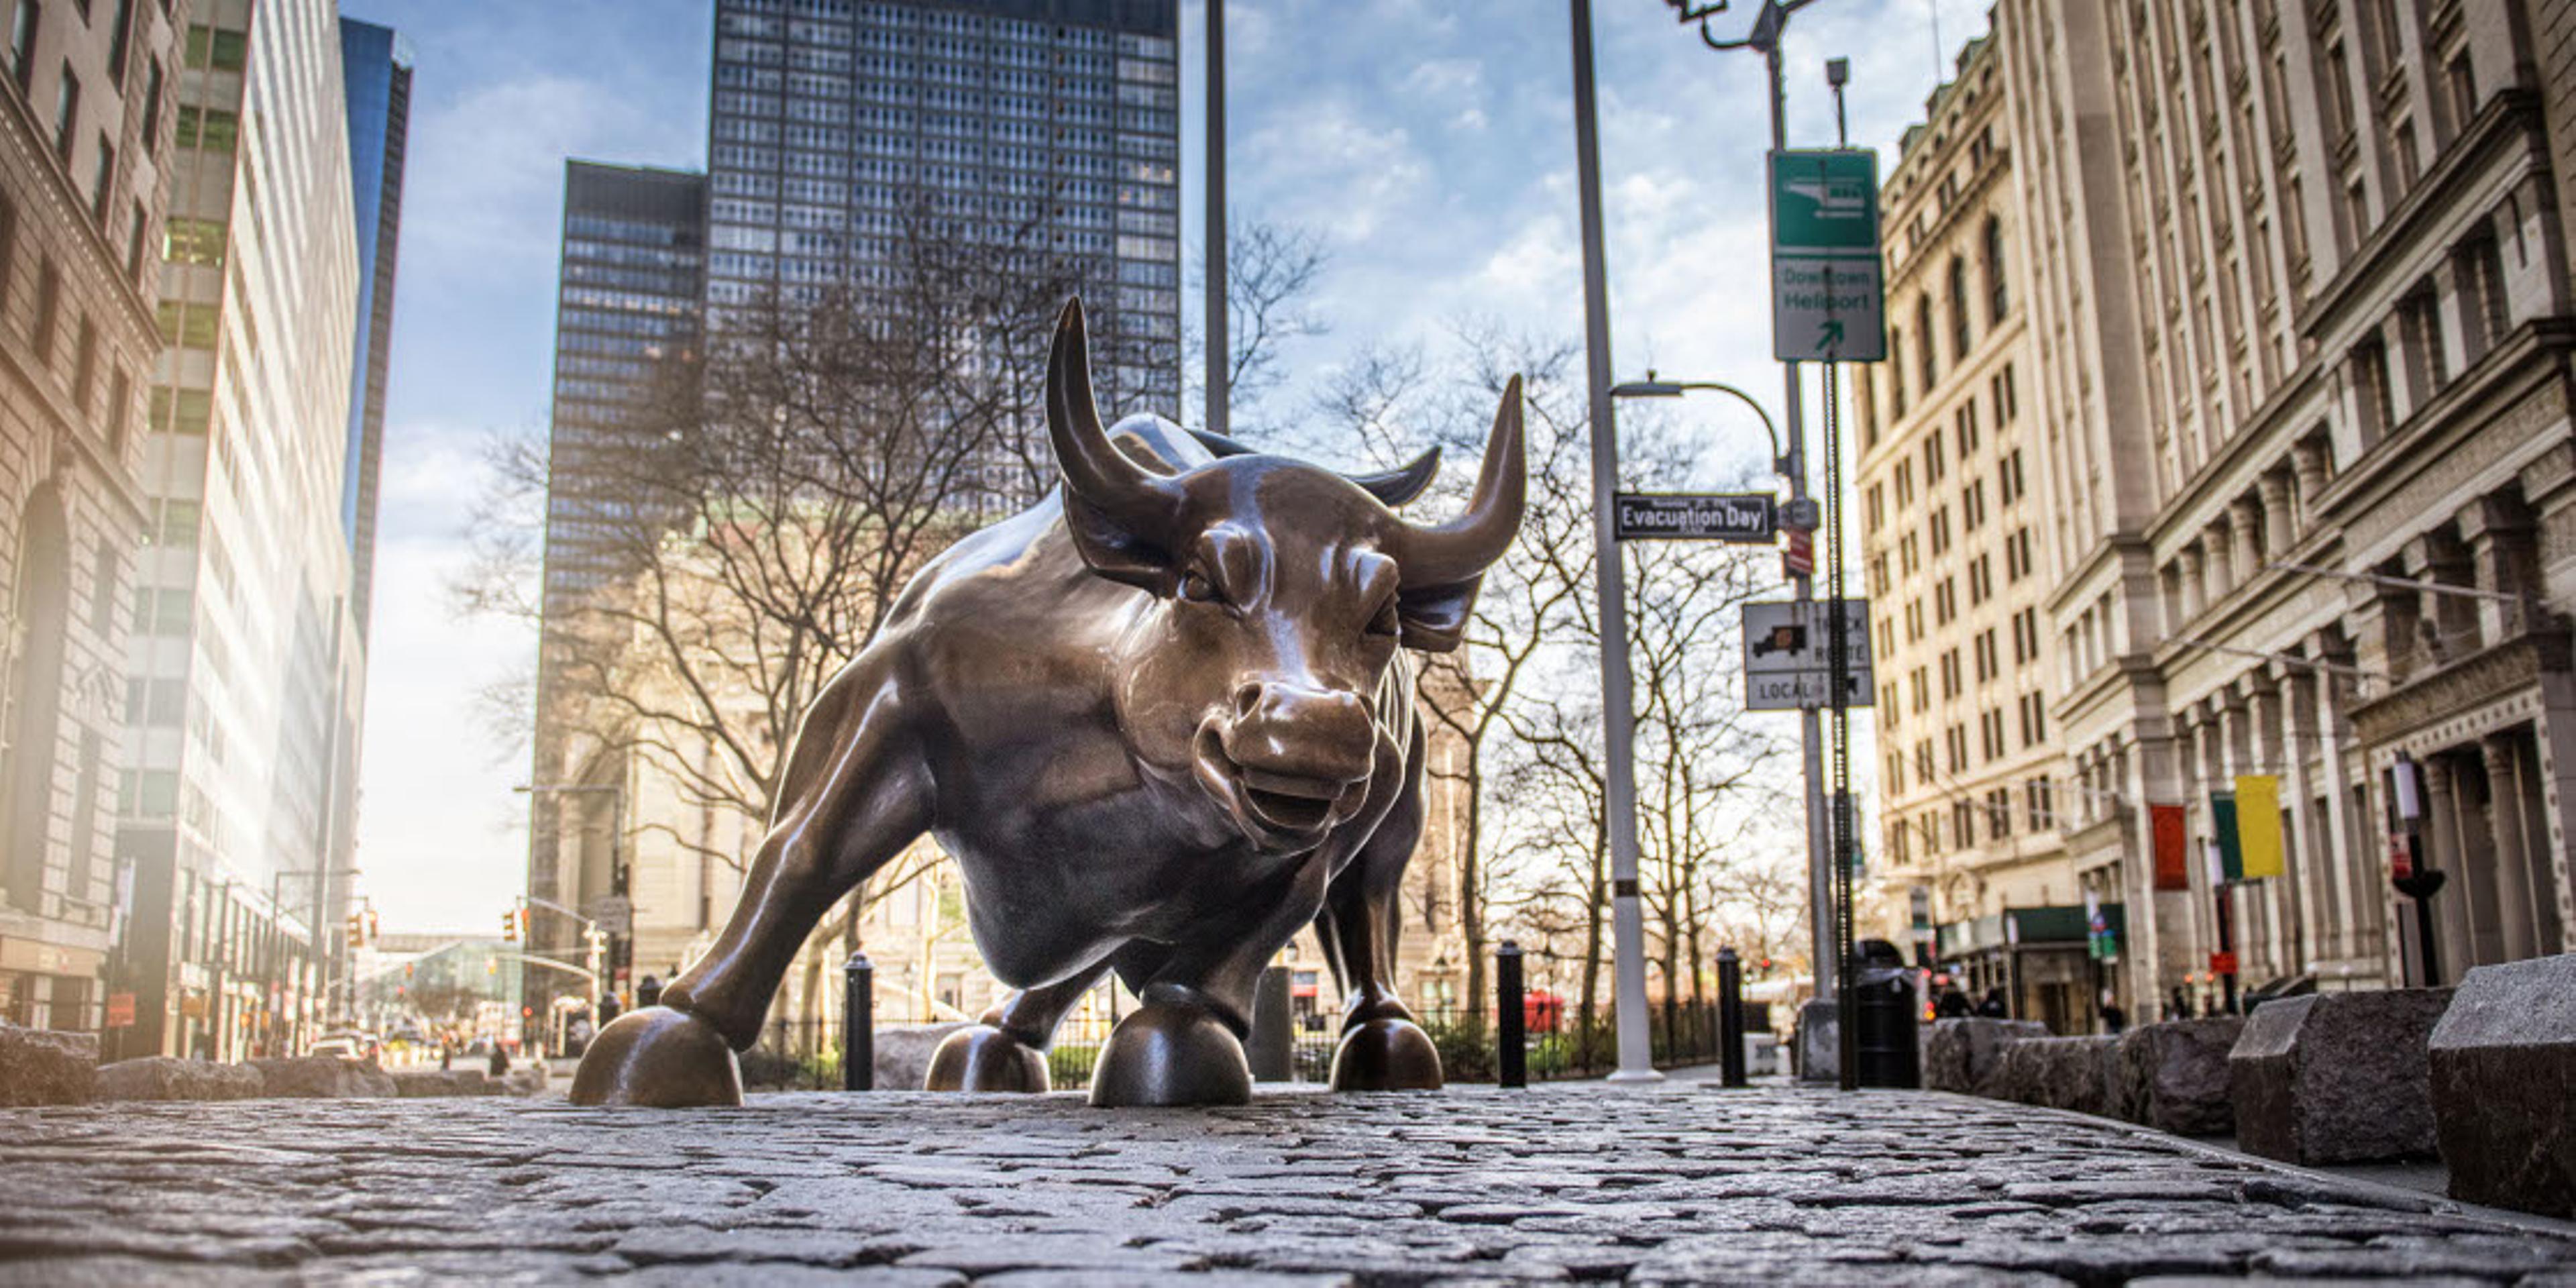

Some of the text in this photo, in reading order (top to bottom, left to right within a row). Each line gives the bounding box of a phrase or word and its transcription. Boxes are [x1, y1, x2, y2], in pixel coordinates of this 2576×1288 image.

[1622, 505, 1724, 527] Evacuation
[1726, 505, 1762, 531] Day
[1759, 682, 1811, 700] LOCAL
